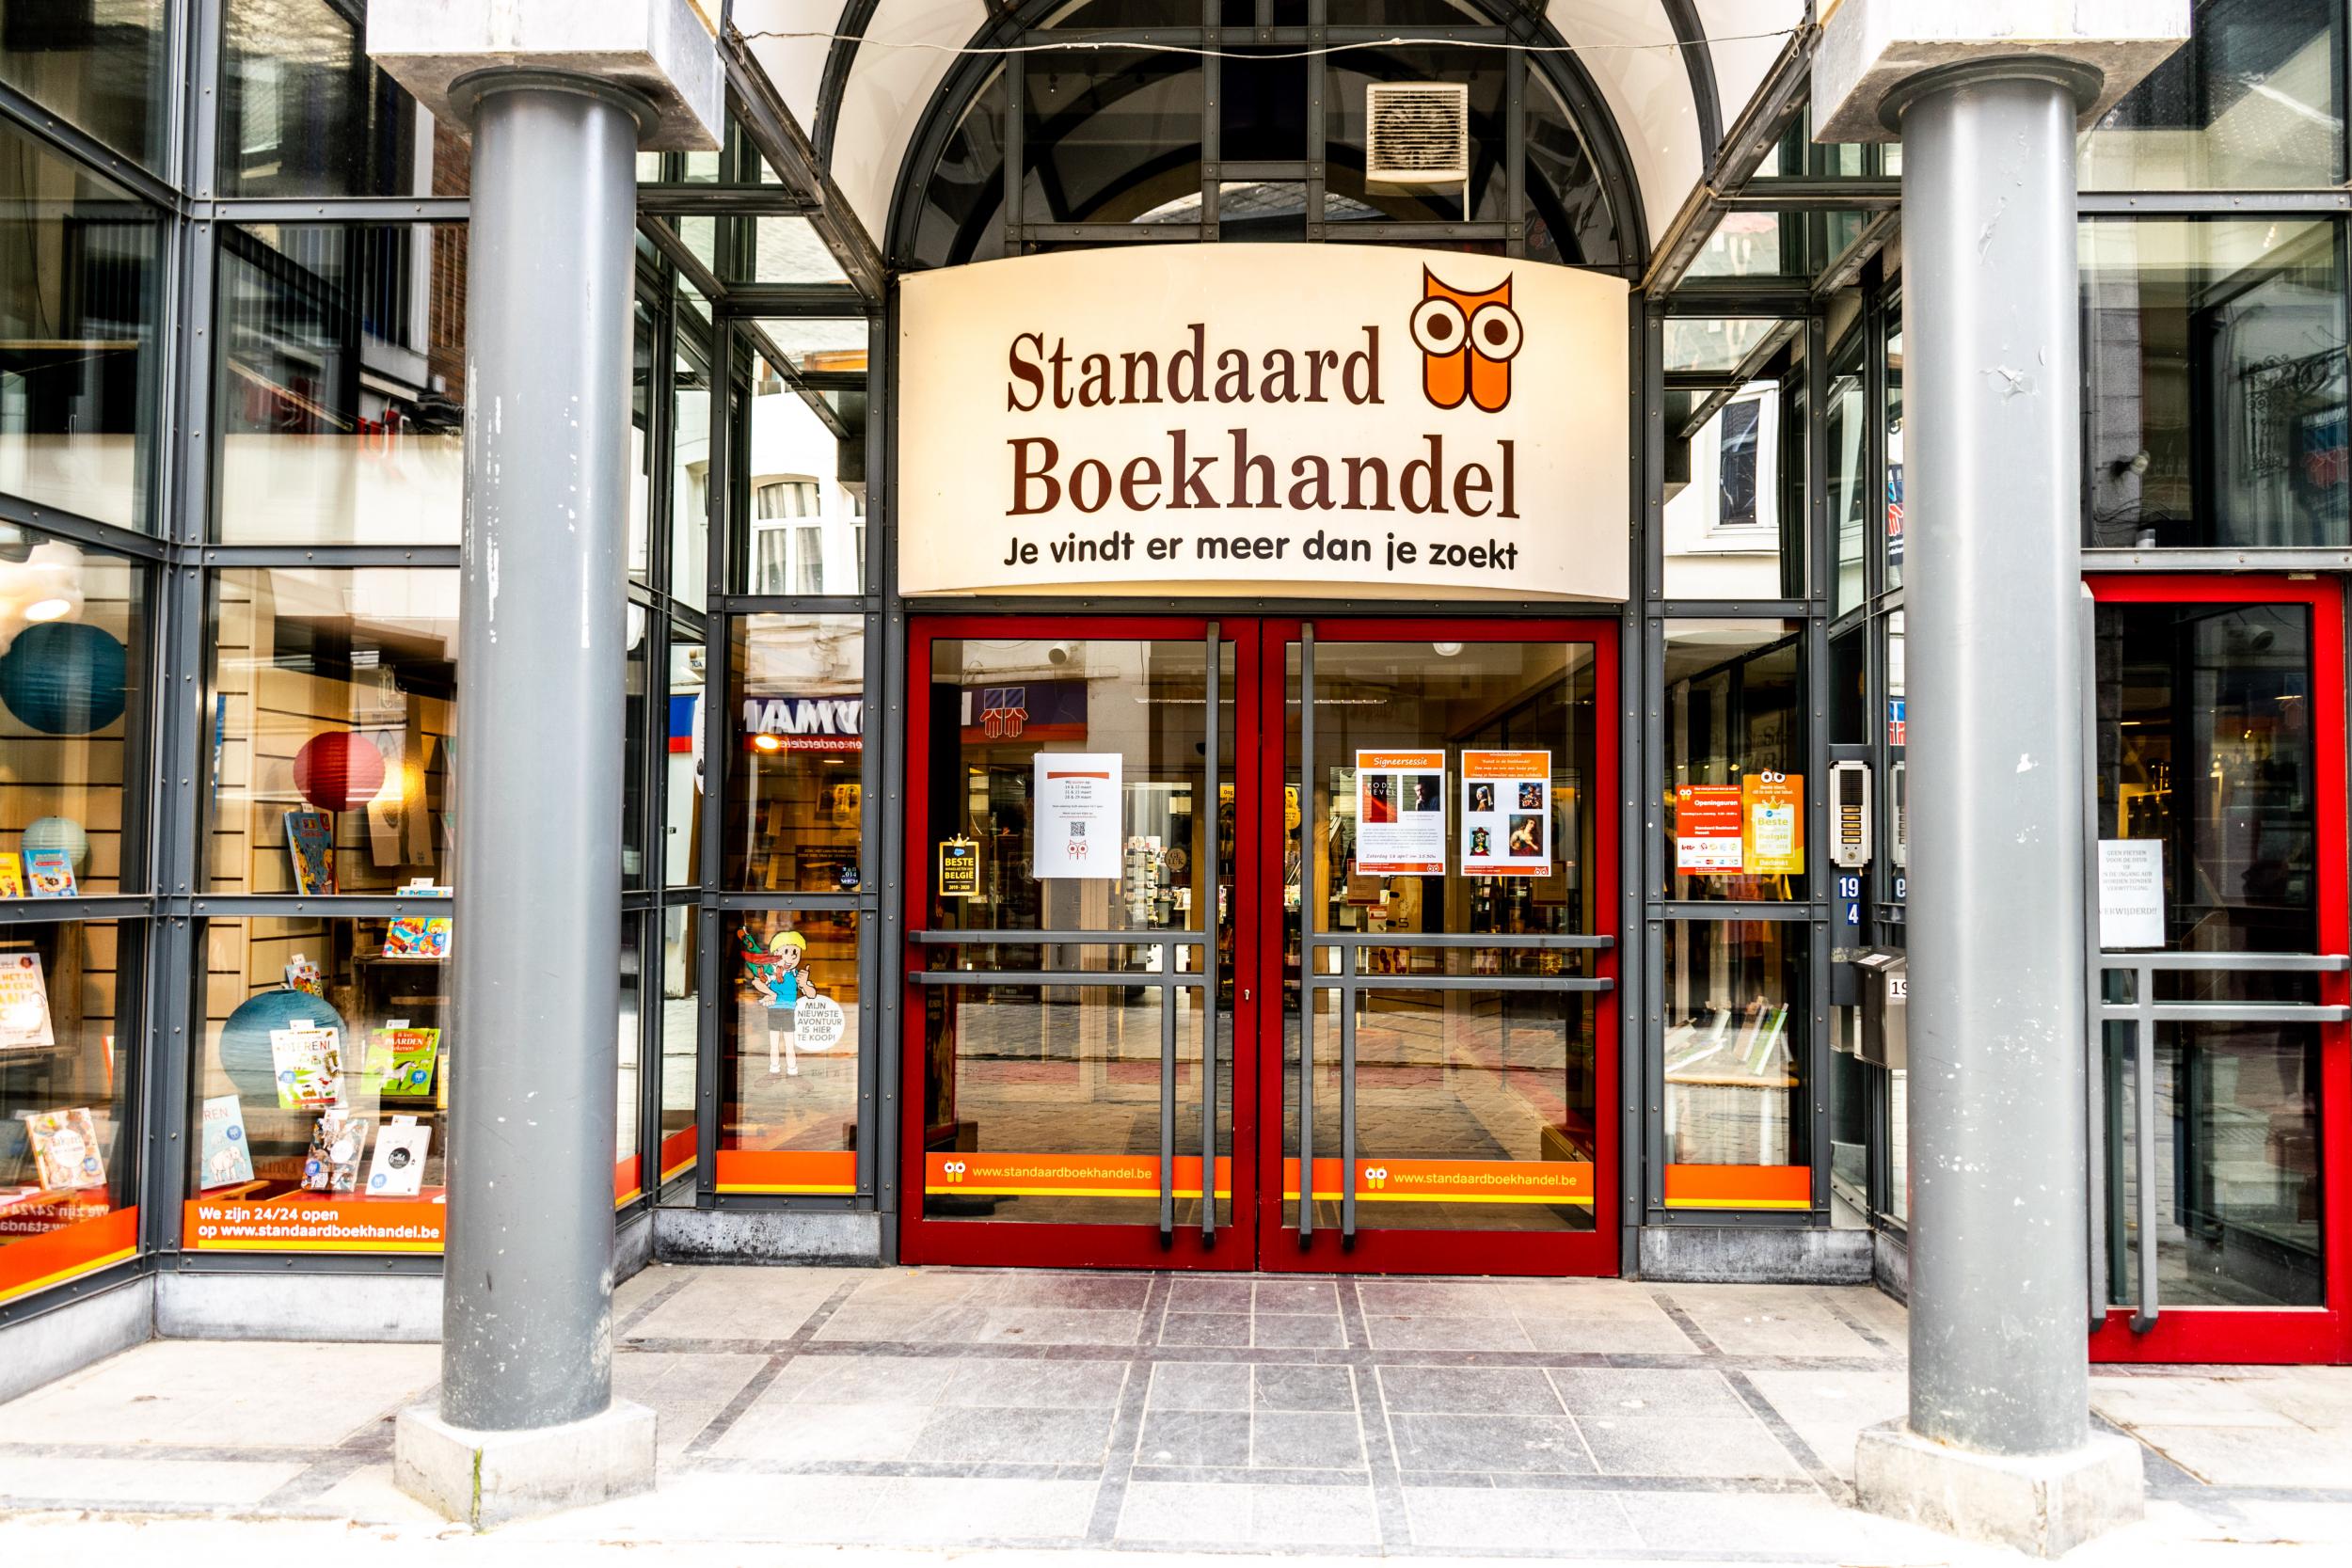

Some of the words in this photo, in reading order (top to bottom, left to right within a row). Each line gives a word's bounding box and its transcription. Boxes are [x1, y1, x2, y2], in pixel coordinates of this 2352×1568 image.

[1008, 323, 1385, 413] Standaard
[1006, 428, 1520, 519] Boekhandel
[1004, 537, 1039, 566] Je
[1050, 531, 1134, 562] vindt
[1146, 536, 1183, 562] er
[1197, 536, 1290, 561] meer
[1302, 530, 1372, 562] dan
[1386, 532, 1417, 571] je
[1429, 538, 1518, 570] zoekt
[1373, 757, 1428, 768] Signeersessie
[945, 858, 974, 866] BESTE
[945, 871, 974, 879] BELGIË
[1839, 877, 1859, 897] 19
[1848, 904, 1859, 924] 4
[973, 1167, 1152, 1180] www.standaardboekhandel.be
[1394, 1173, 1577, 1186] www.standaardboekhandel.be
[199, 1207, 221, 1220] We
[225, 1207, 250, 1222] zijn
[254, 1207, 298, 1220] 24/24
[302, 1209, 338, 1224] open
[198, 1226, 217, 1239] op
[221, 1225, 440, 1239] www.standaardboekhandel.be
